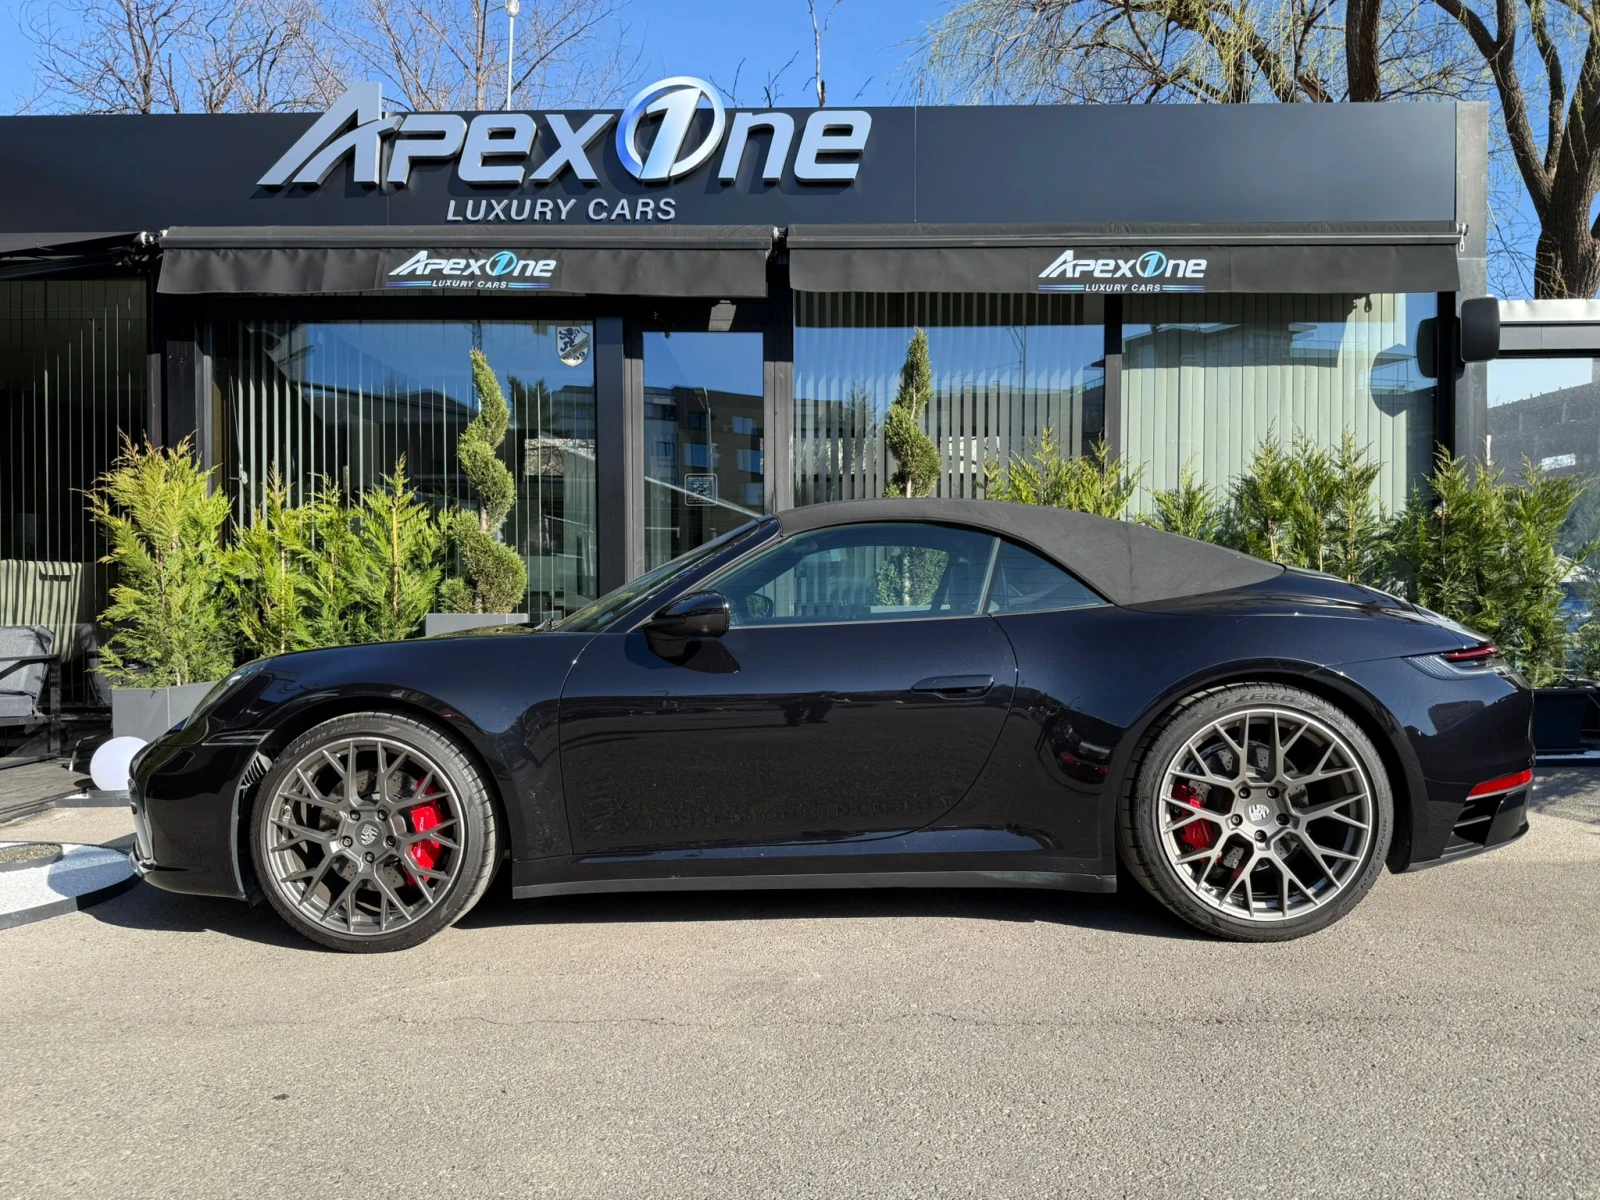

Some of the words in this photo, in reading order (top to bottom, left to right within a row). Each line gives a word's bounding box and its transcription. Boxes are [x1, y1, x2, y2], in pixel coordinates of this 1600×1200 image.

[446, 199, 577, 221] LUXURY
[587, 198, 677, 221] CARS
[431, 280, 475, 288] LUXURY
[477, 280, 507, 289] CARS
[1085, 284, 1128, 292] LUXURY
[1131, 284, 1161, 292] CARS
[1235, 692, 1297, 703] ZERO
